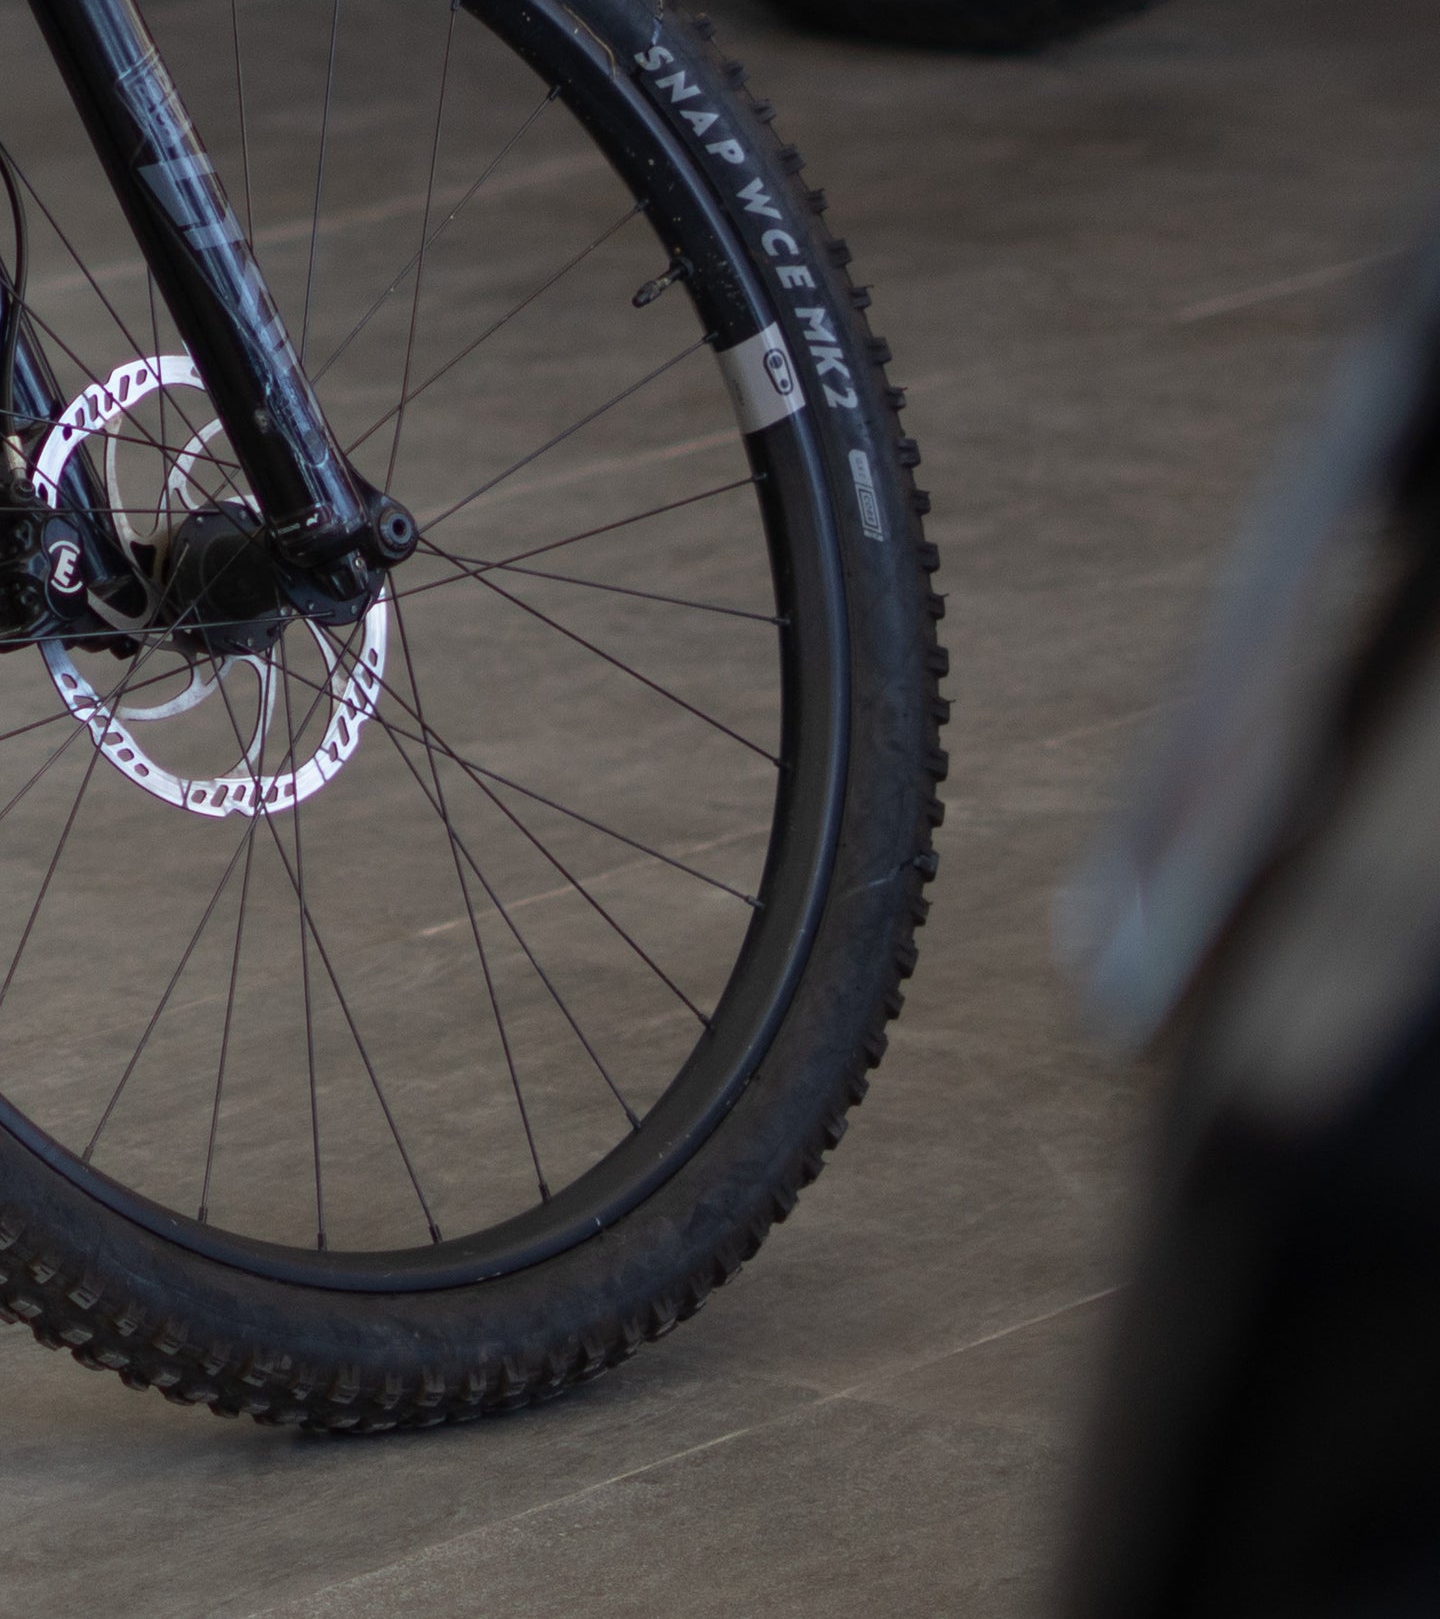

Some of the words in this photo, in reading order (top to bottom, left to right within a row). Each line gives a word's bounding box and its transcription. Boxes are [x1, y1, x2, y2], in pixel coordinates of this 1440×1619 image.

[635, 44, 744, 164] SNAP
[736, 178, 814, 290] WCE
[794, 306, 858, 410] MK2
